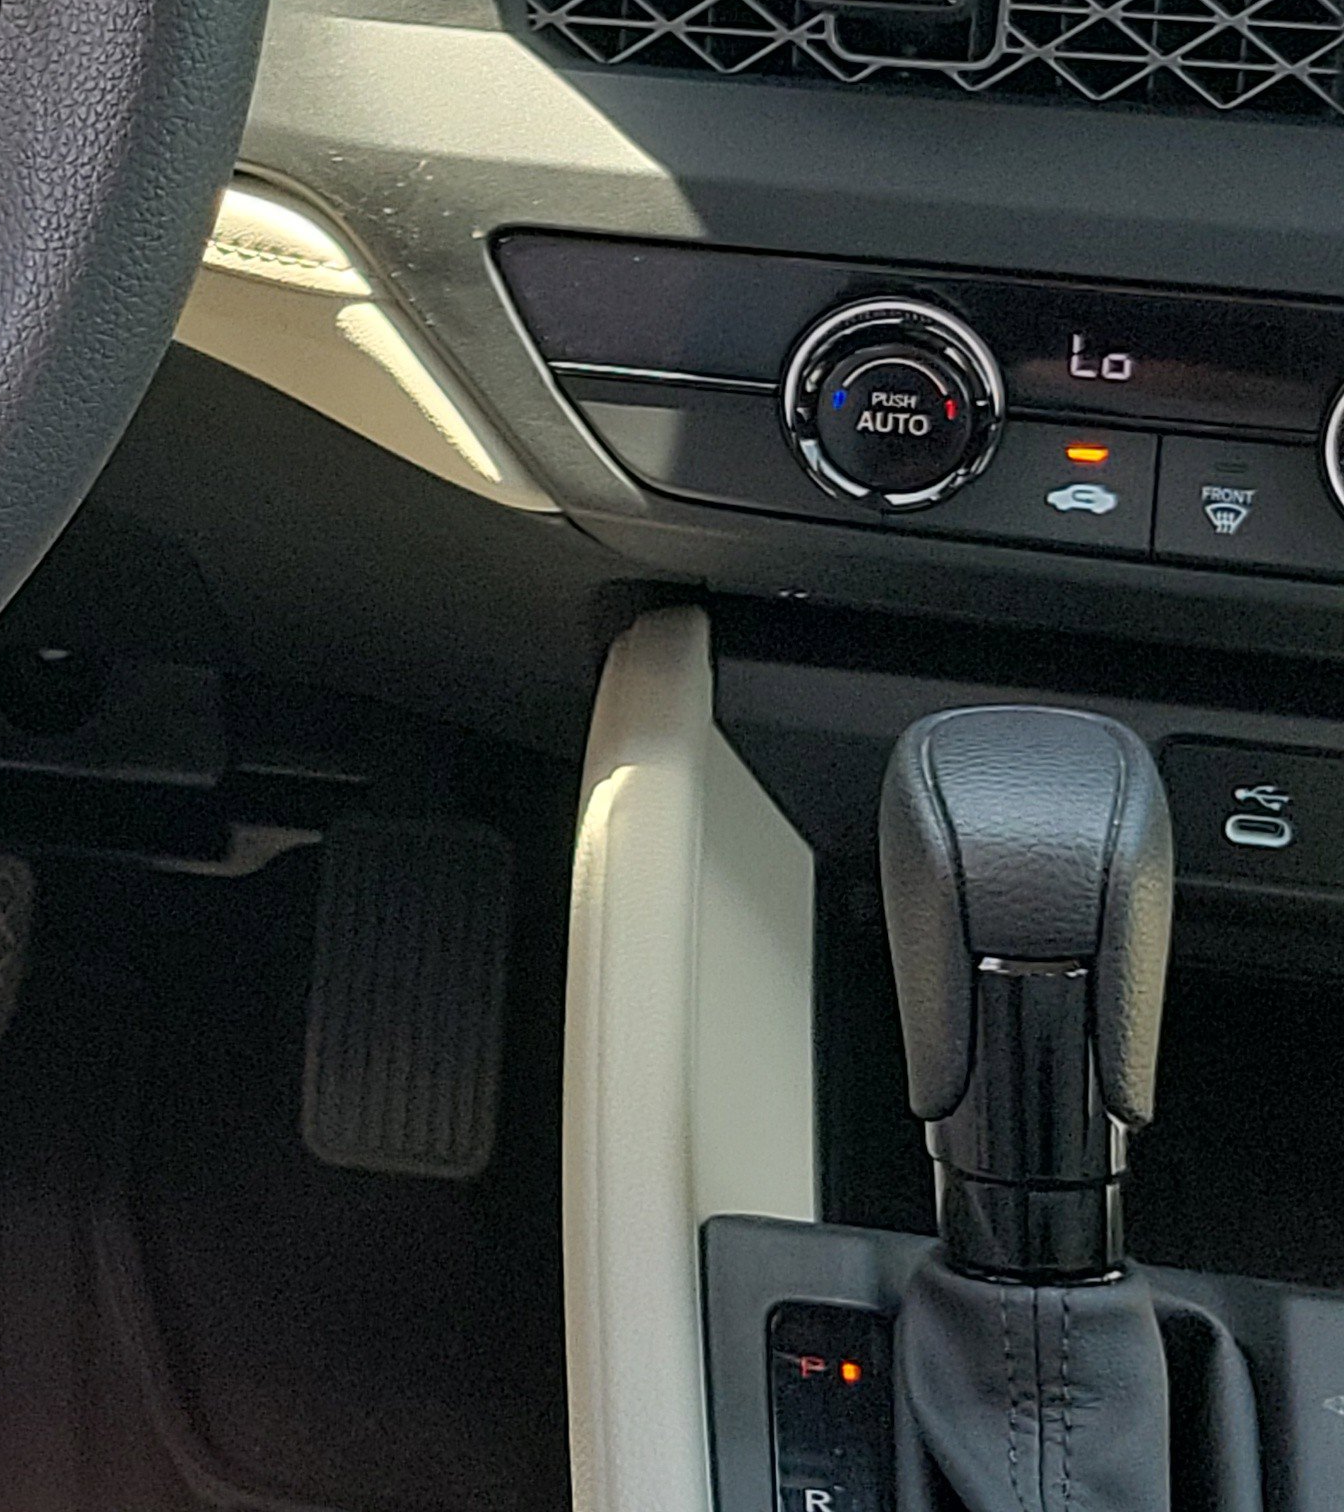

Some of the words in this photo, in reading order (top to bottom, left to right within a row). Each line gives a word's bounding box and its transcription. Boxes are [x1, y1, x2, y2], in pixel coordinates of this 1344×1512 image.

[1068, 333, 1133, 381] Lo
[872, 391, 917, 409] PUSH
[856, 411, 931, 437] AUTO
[1201, 486, 1255, 504] FRONT
[801, 1357, 827, 1379] P
[805, 1489, 833, 1512] R
